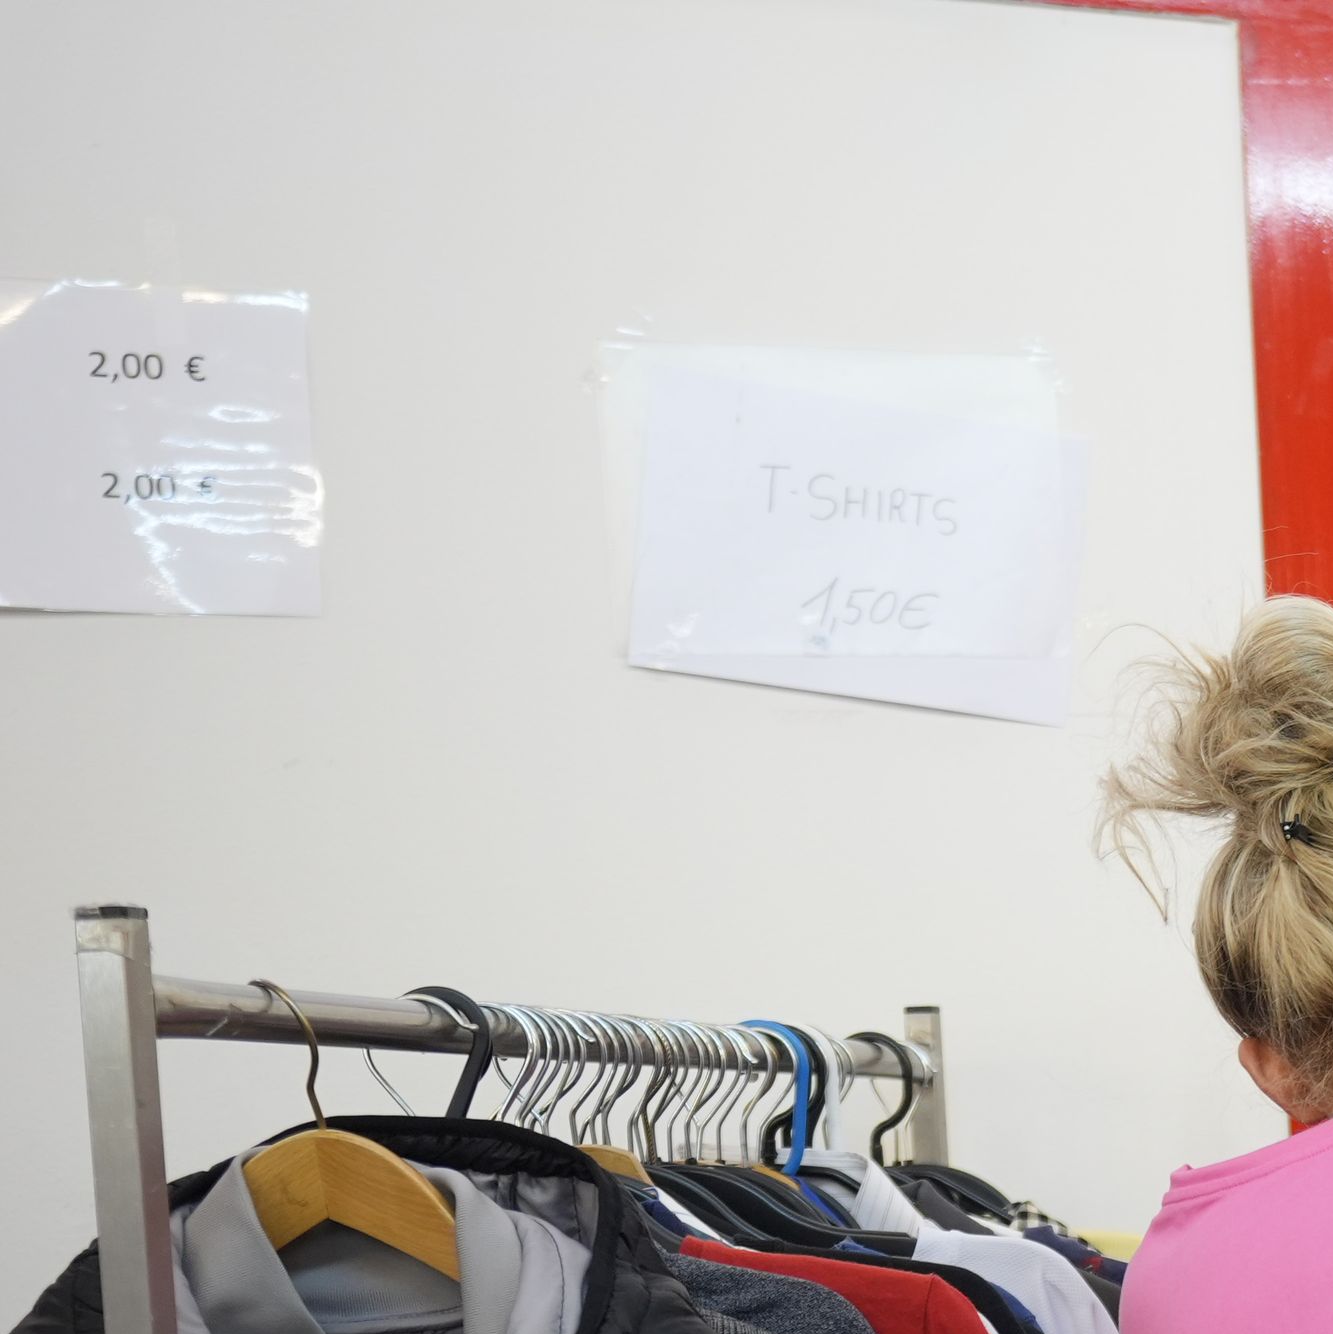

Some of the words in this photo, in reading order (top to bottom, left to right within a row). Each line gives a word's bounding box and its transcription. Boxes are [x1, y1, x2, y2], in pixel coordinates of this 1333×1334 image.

[89, 351, 164, 383] 2,00
[184, 356, 206, 381] €
[101, 472, 176, 504] 2,00
[197, 475, 217, 500] €
[800, 577, 939, 632] 1,50€
